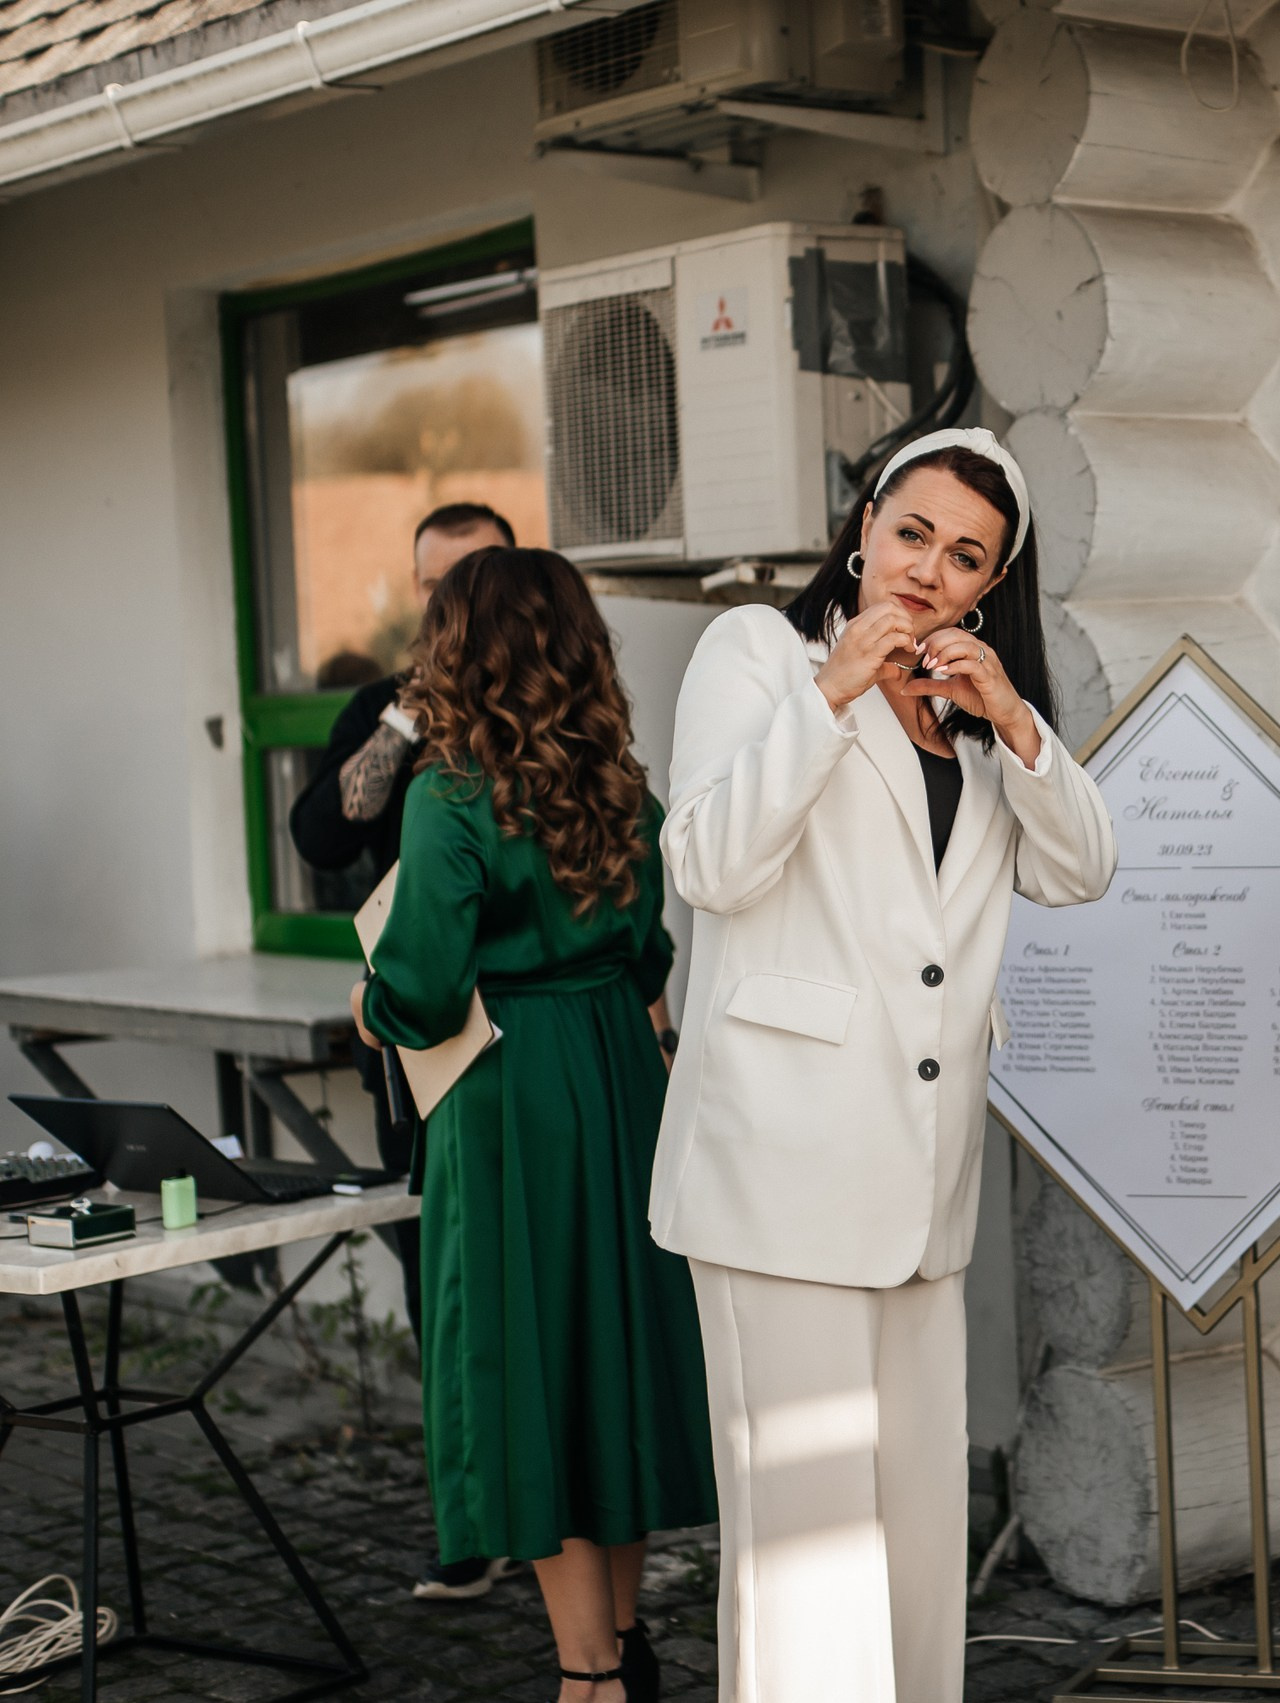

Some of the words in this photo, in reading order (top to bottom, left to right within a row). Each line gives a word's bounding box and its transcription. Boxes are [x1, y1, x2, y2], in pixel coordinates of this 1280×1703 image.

[1139, 756, 1219, 782] Евгений
[1220, 778, 1240, 801] &
[1122, 795, 1233, 821] Наталья
[1121, 886, 1158, 905] Стол
[1023, 942, 1058, 958] Стол
[1172, 941, 1209, 958] Стол
